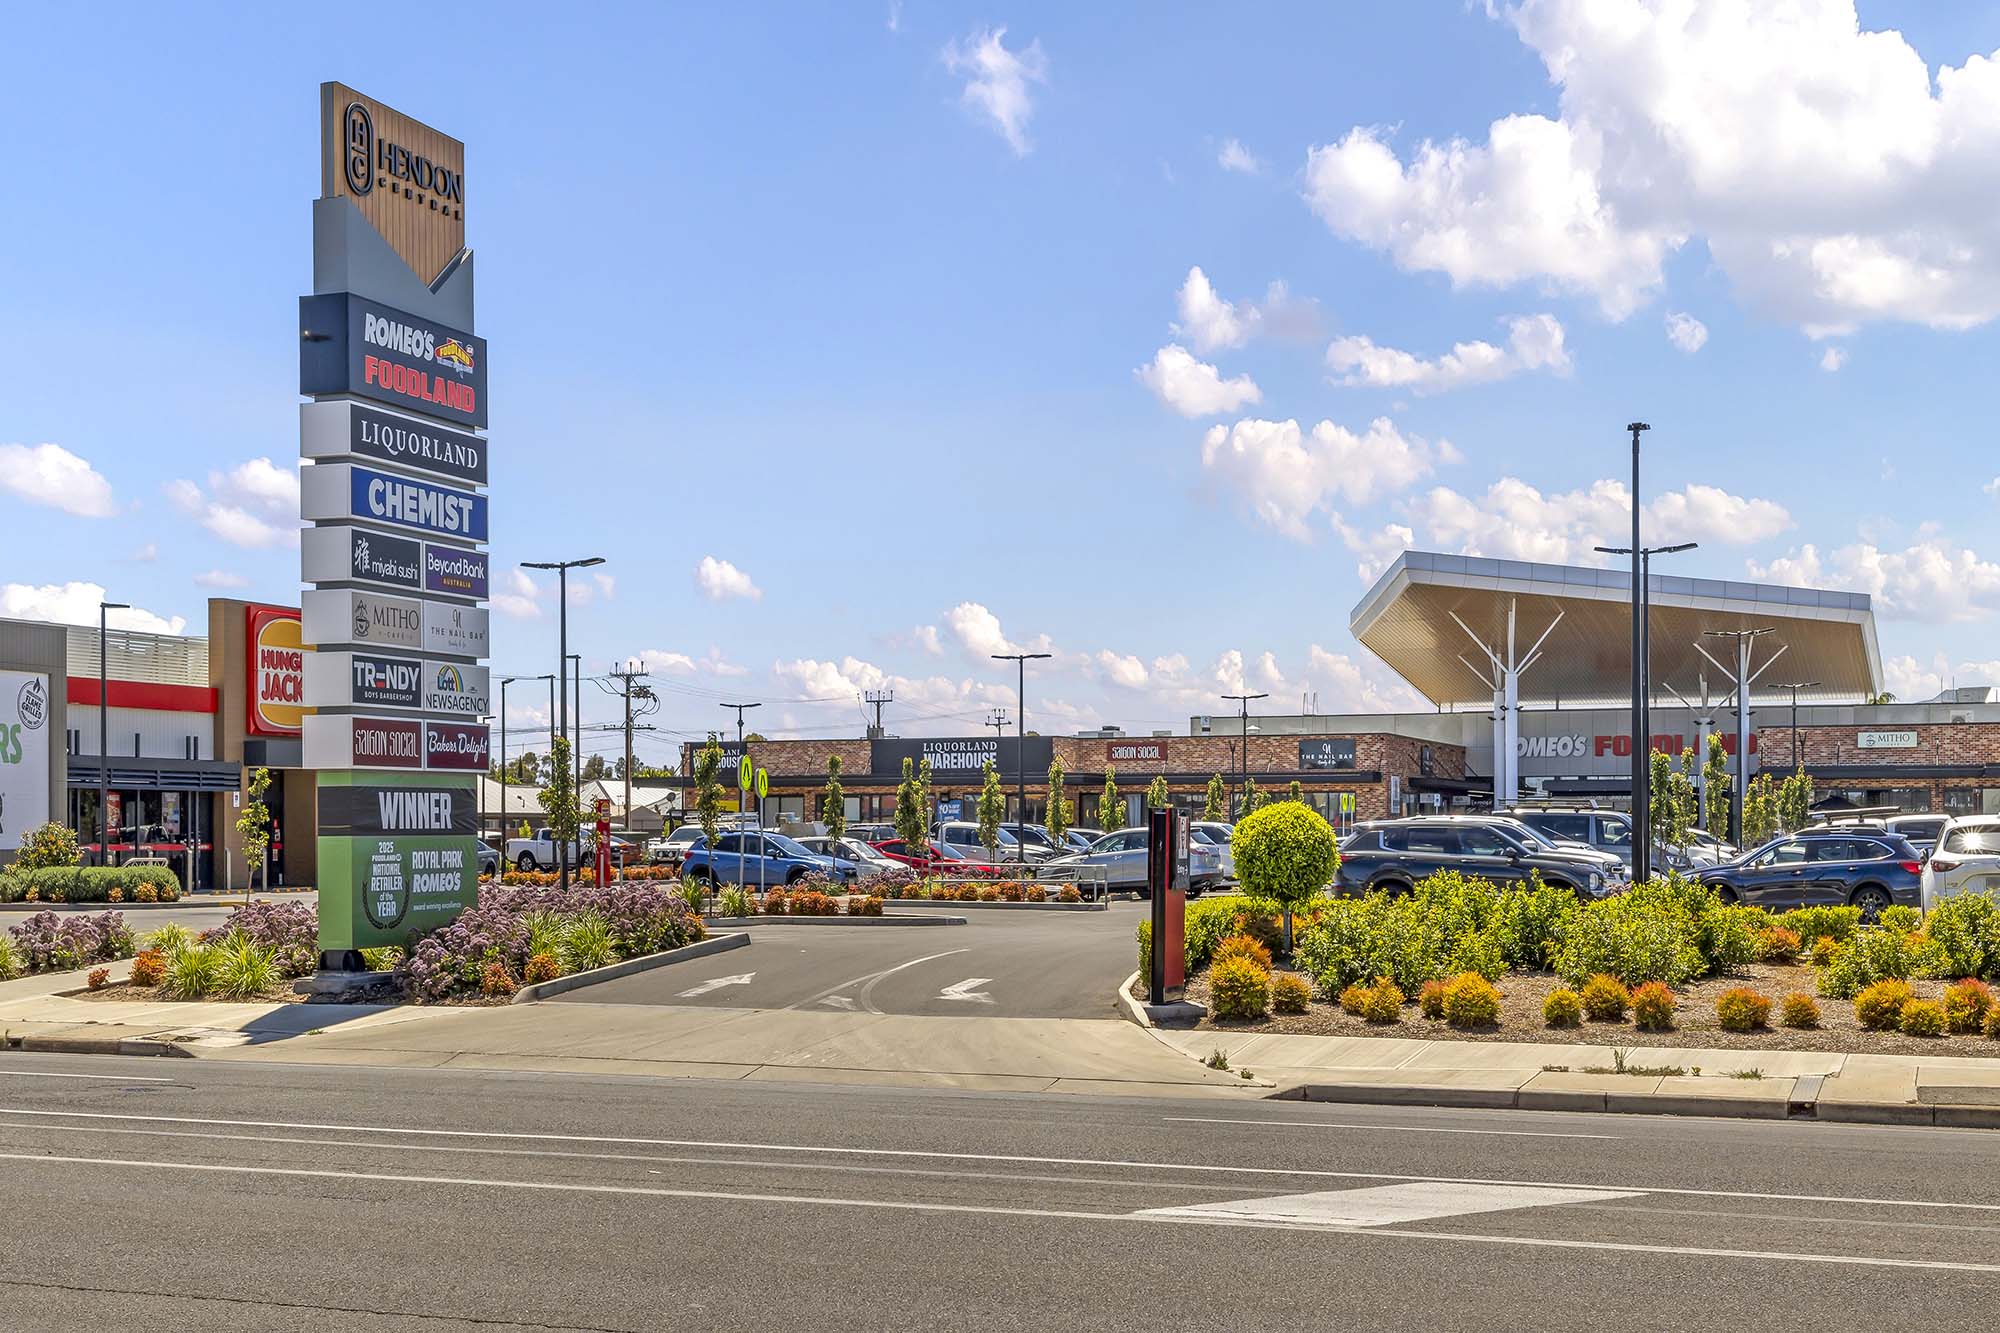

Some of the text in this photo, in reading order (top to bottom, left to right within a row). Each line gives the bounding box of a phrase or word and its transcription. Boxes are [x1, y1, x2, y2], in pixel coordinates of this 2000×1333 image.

[378, 138, 462, 204] HENDON
[364, 312, 435, 361] ROMEO'S
[365, 354, 475, 413] FOODLAND
[361, 420, 479, 469] LIQUORLAND
[368, 478, 473, 533] CHEMIST
[371, 557, 419, 580] miyabi sushi
[428, 552, 486, 580] Beyond Bank
[442, 577, 472, 589] AUSTRALIA
[373, 605, 420, 631] MITHO
[431, 626, 483, 641] THE NAIL BAR
[261, 649, 302, 672] HUNG
[261, 672, 302, 703] JACK
[364, 691, 413, 702] BOYS BARBERSHOP
[426, 693, 489, 713] NEWSAGENCY
[0, 723, 22, 764] RS
[428, 730, 488, 763] Bakers Delight
[923, 741, 997, 754] LIQUORLAND
[1518, 733, 1587, 757] OMEO'S
[1878, 733, 1910, 743] MITHO
[923, 752, 997, 769] WAREHOUSE
[378, 791, 453, 830] WINNER
[378, 841, 394, 853] 2025
[372, 863, 401, 876] NATIONAL
[412, 850, 463, 869] ROYAL PARK
[371, 876, 403, 891] RETAILER
[413, 870, 461, 893] ROMEO'S
[376, 901, 397, 917] YEAR
